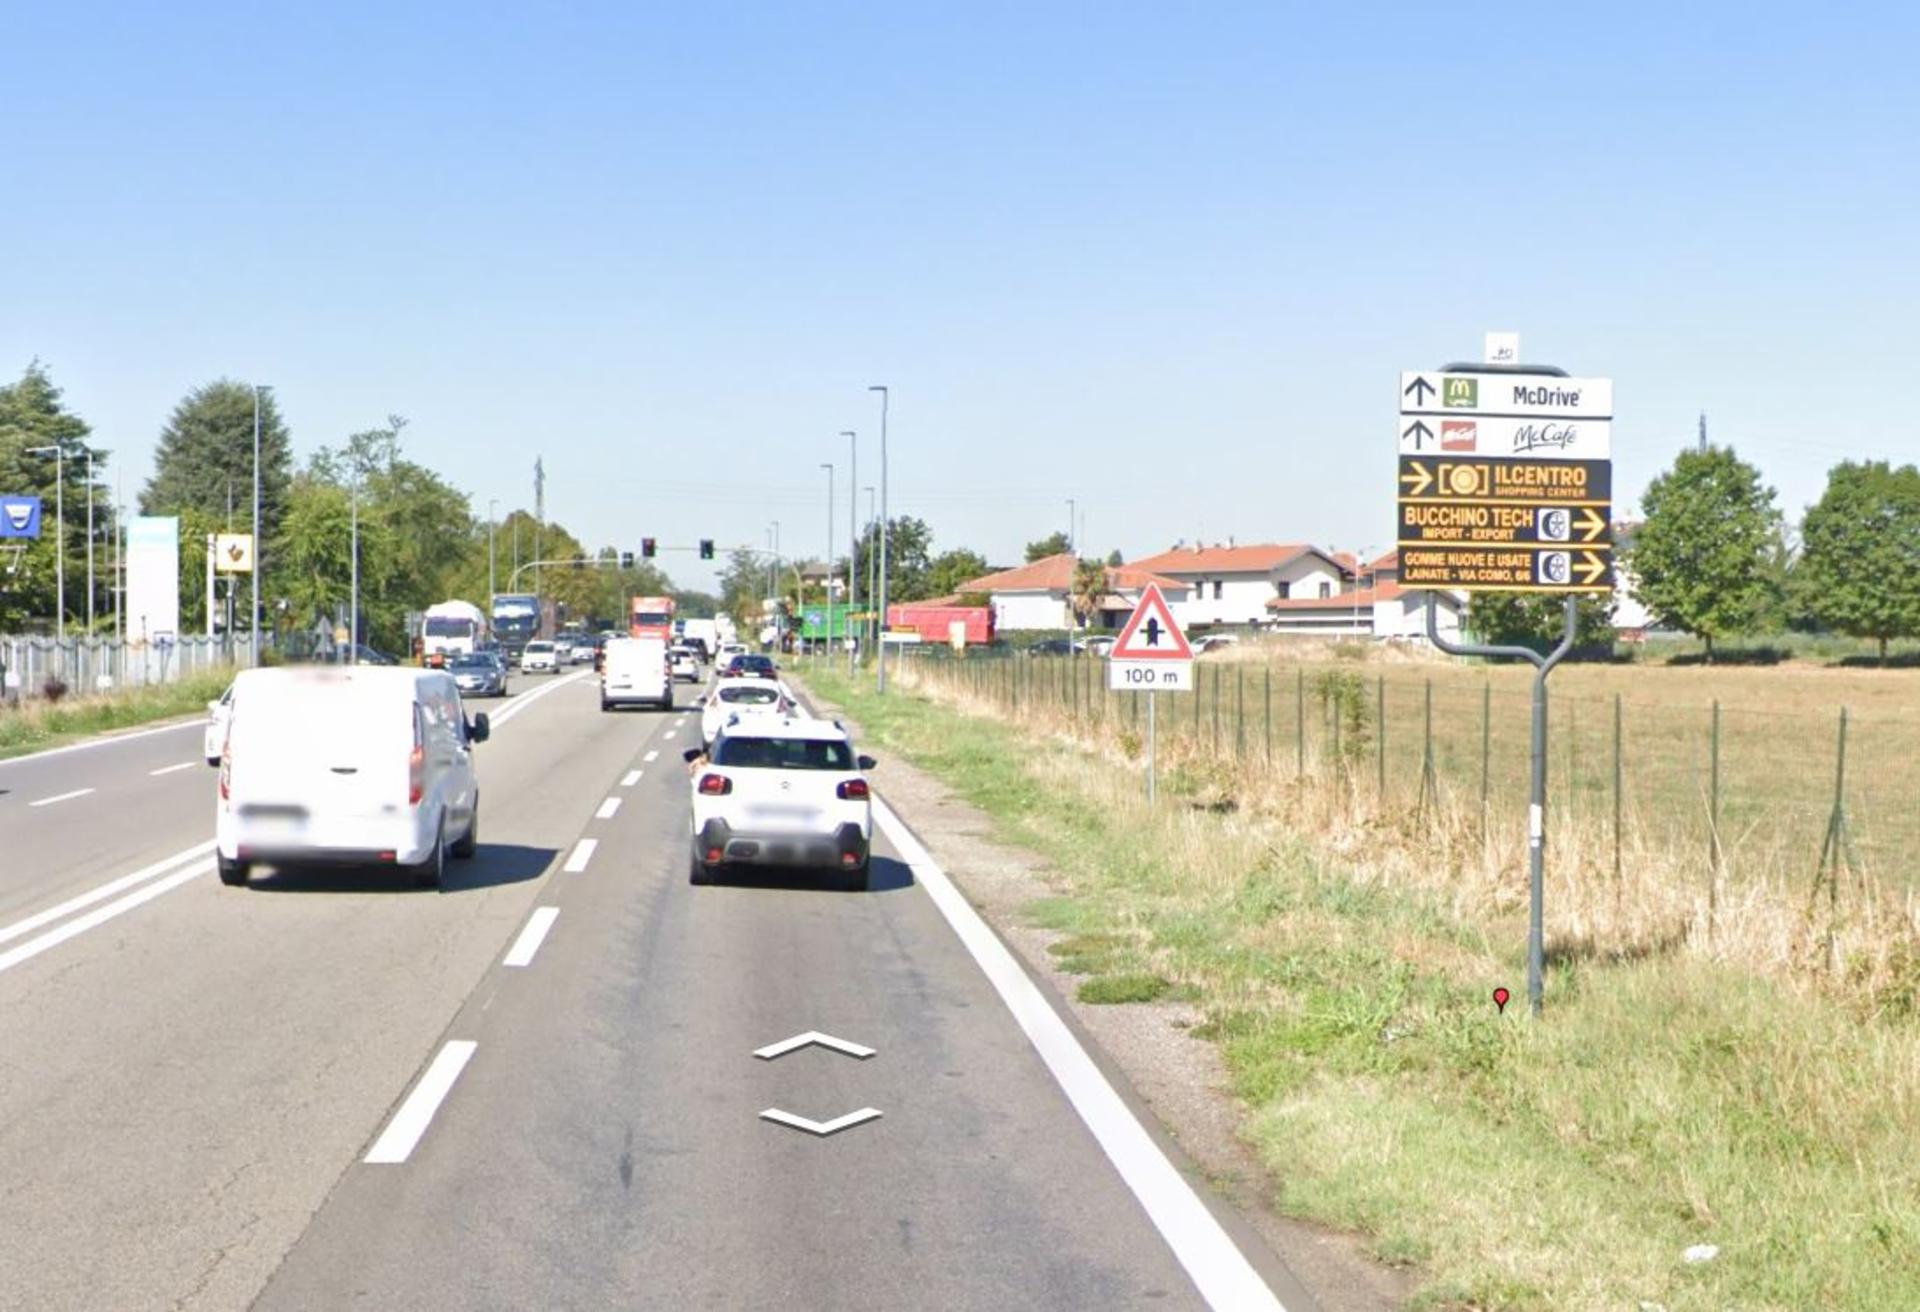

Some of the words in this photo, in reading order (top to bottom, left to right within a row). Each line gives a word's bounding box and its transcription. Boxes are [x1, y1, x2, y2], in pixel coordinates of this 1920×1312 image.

[1513, 385, 1579, 407] McDrive
[1494, 466, 1586, 486] ILCENTRO
[1546, 487, 1586, 498] CENTER
[1404, 506, 1488, 527] BUCCHINO
[1491, 508, 1534, 528] TECH
[1422, 527, 1464, 539] IMPORT
[1471, 528, 1515, 540] EXPORT
[1404, 551, 1446, 567] GOMME
[1447, 552, 1485, 567] NUOVE
[1486, 553, 1495, 567] E
[1497, 553, 1532, 568] USATE
[1404, 567, 1450, 580] LAINATE
[1458, 569, 1477, 581] VIA
[1125, 668, 1156, 683] 100
[1163, 671, 1178, 683] m
